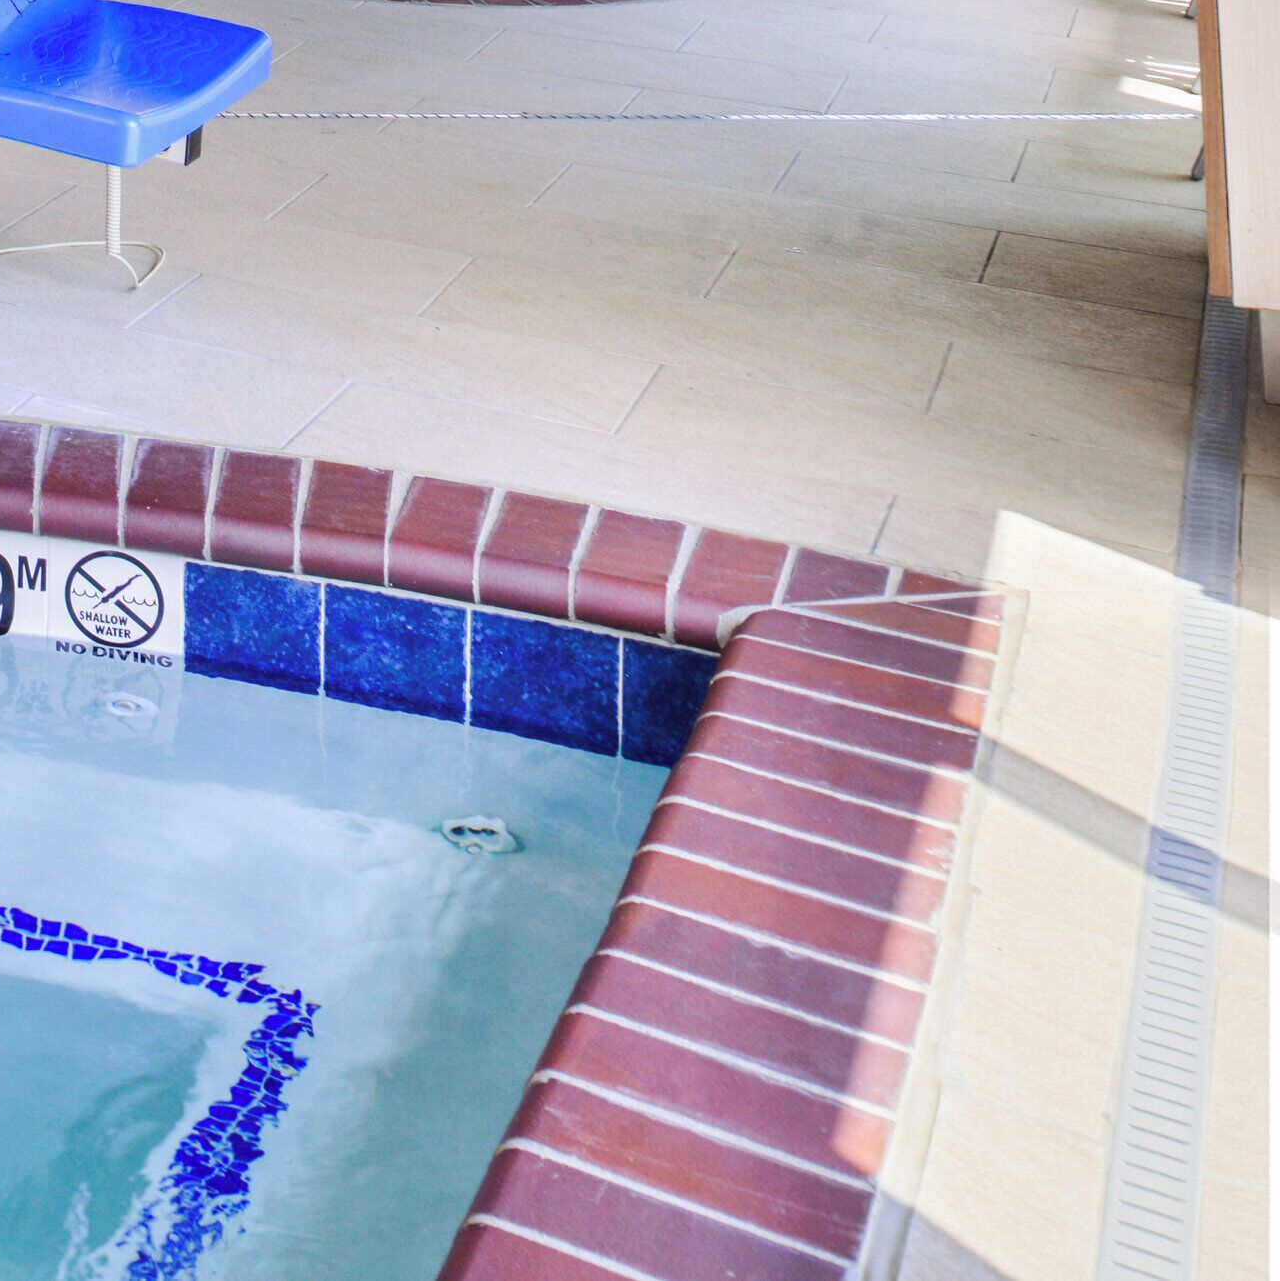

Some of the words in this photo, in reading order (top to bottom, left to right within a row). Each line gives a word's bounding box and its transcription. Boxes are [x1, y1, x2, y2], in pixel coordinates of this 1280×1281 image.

[79, 610, 128, 626] SHALLOW
[95, 624, 132, 639] WATER
[56, 640, 87, 654] NO
[92, 645, 173, 668] DIVING
